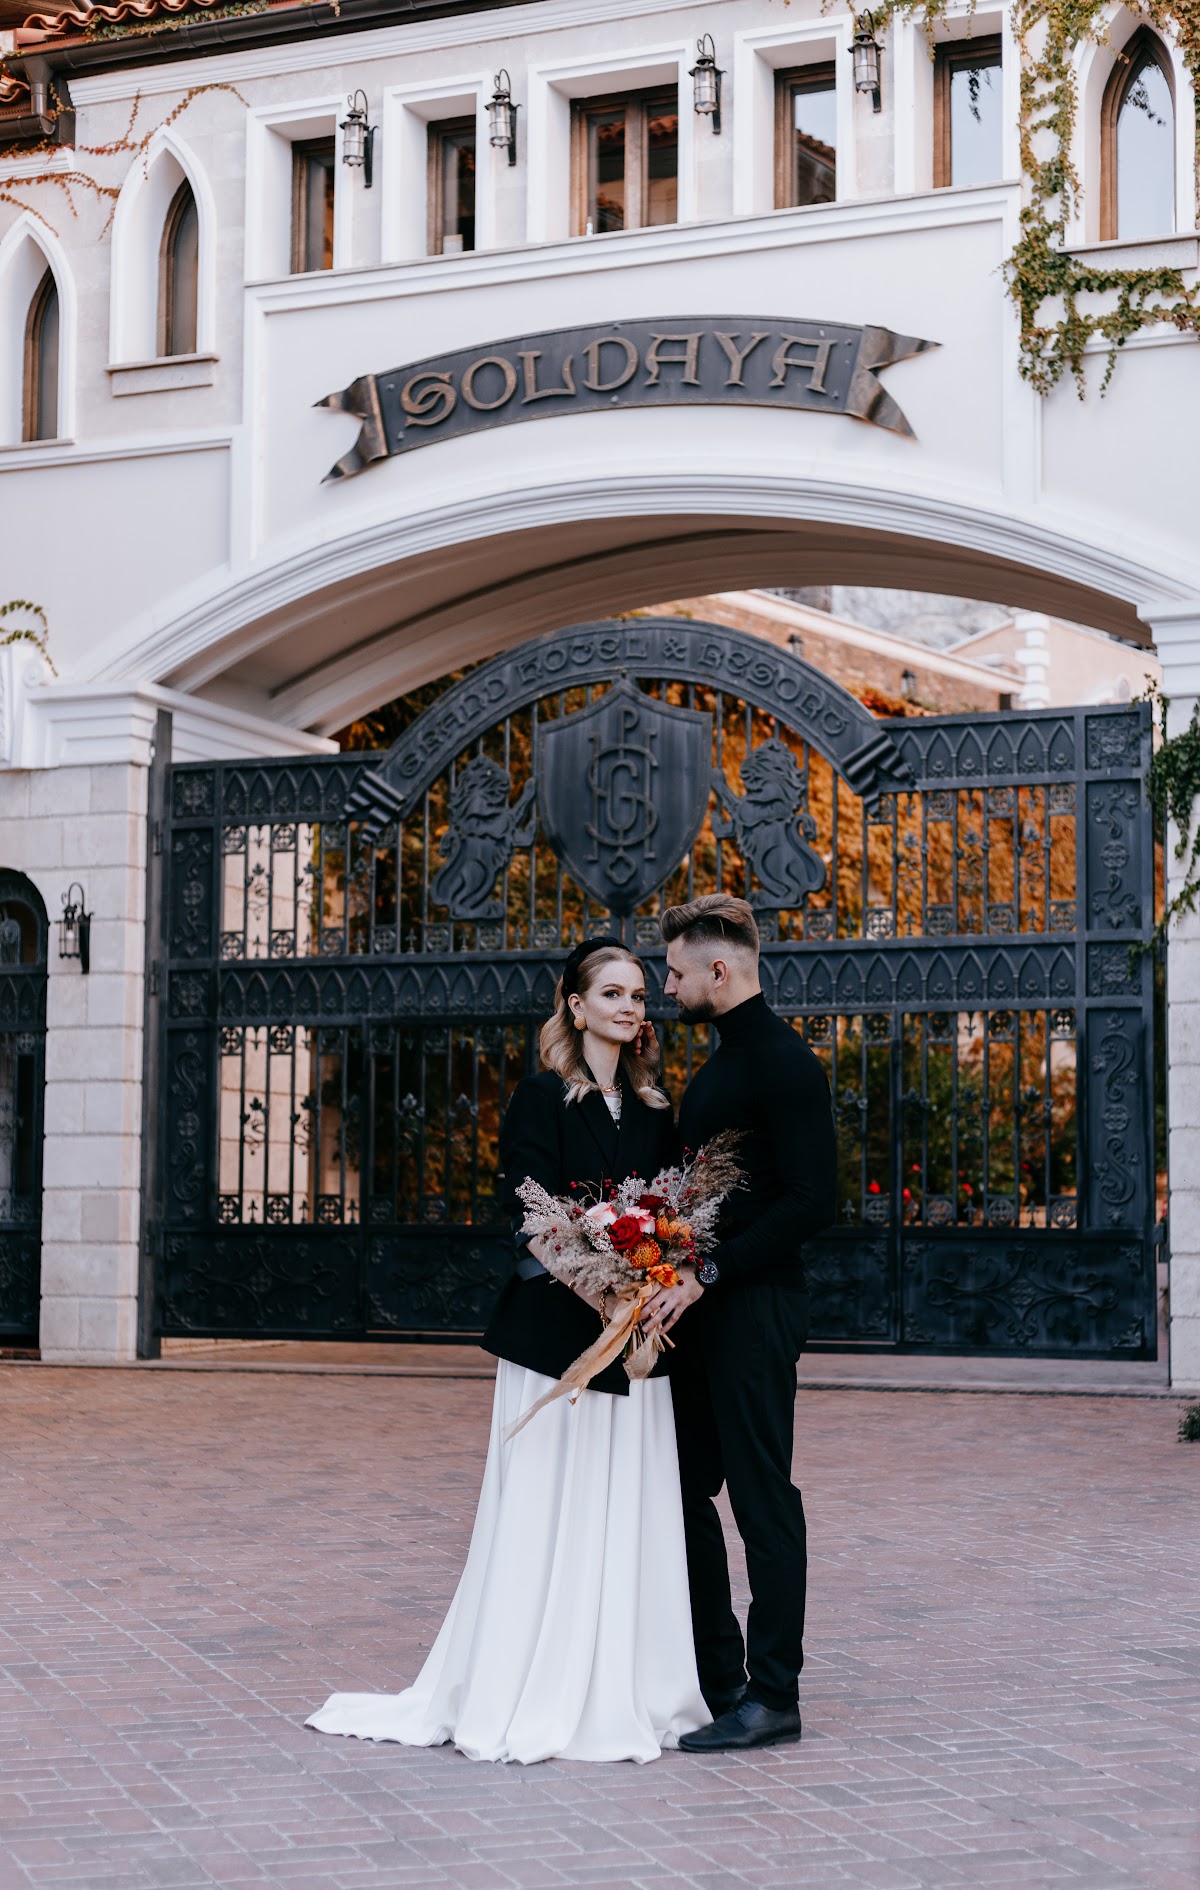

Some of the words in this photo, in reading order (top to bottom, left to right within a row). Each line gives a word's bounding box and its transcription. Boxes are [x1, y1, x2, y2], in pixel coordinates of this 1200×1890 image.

[402, 330, 839, 428] SOLDAYA
[400, 677, 508, 779] GRAND
[516, 636, 648, 686] HOTEL
[662, 636, 688, 661] &
[698, 642, 849, 737] RESORT
